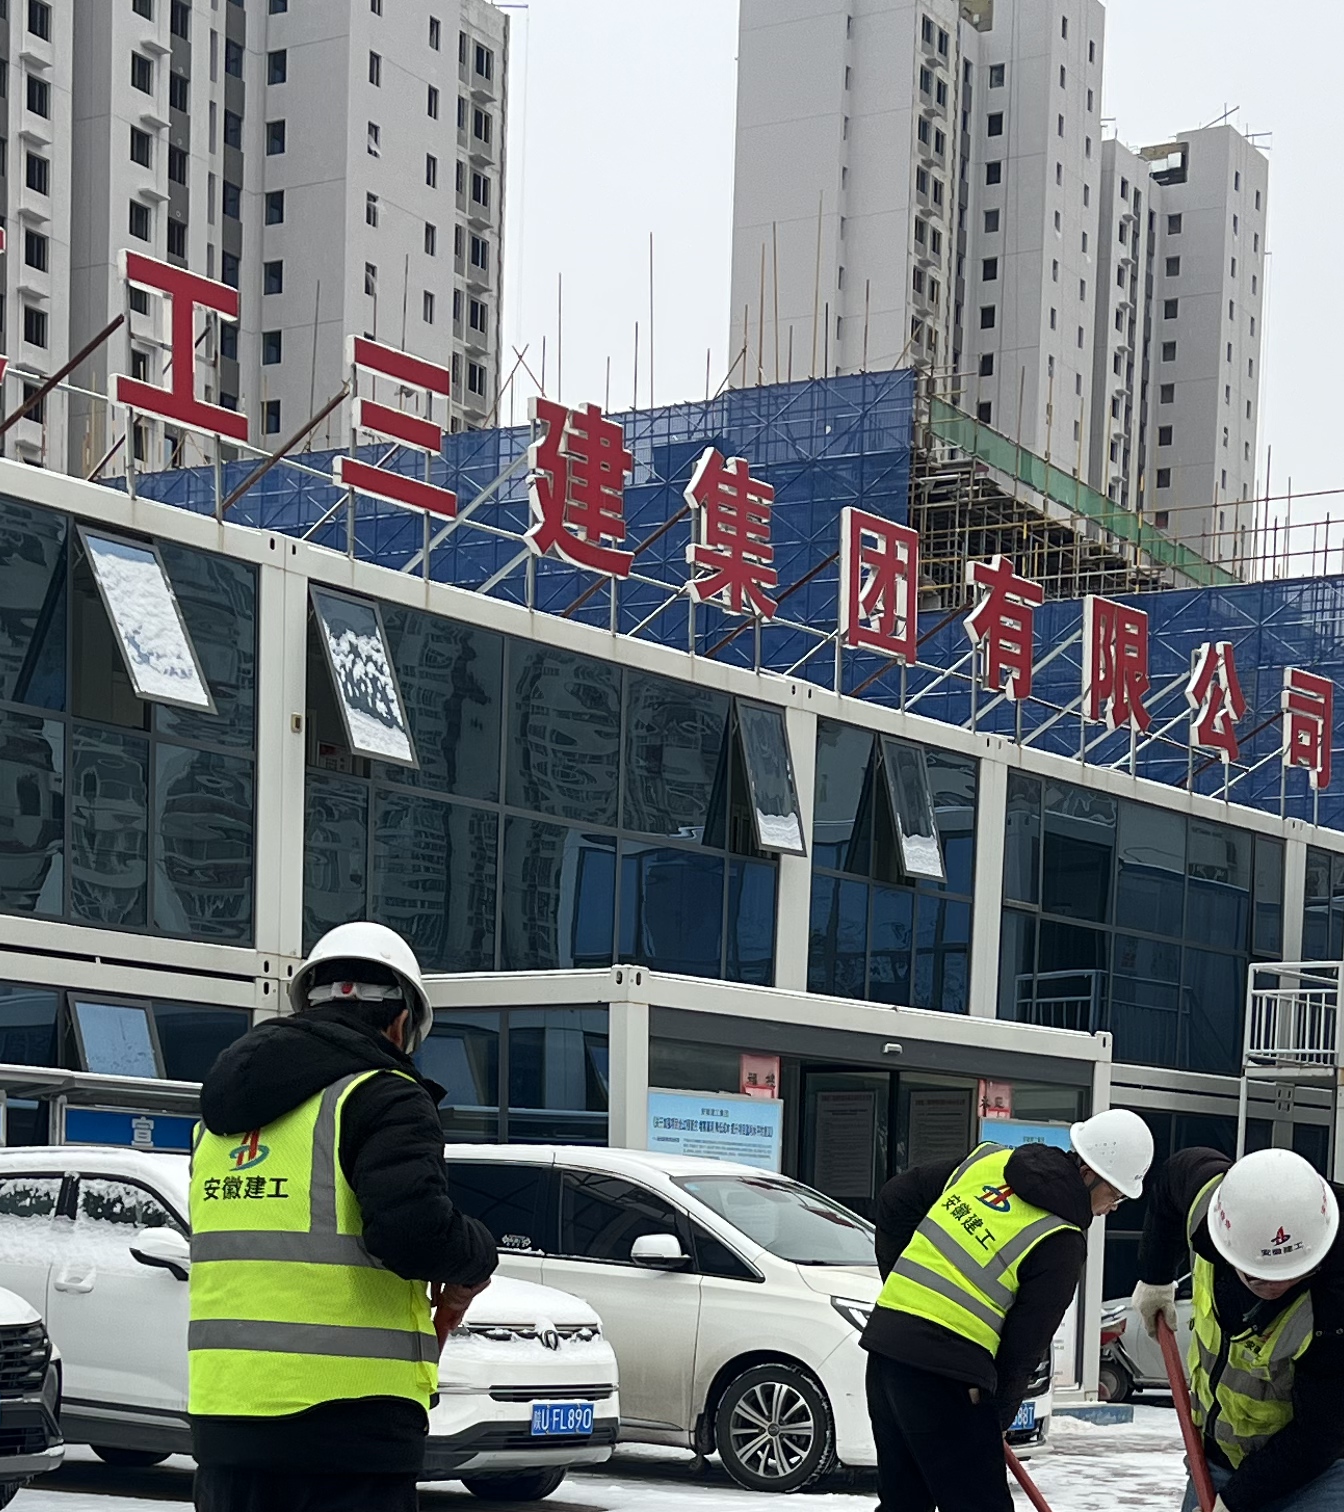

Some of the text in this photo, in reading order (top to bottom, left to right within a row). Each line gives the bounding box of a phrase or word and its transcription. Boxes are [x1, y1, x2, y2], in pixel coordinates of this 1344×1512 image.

[203, 1175, 289, 1201] 安徽建工
[941, 1194, 997, 1251] 安徽建工
